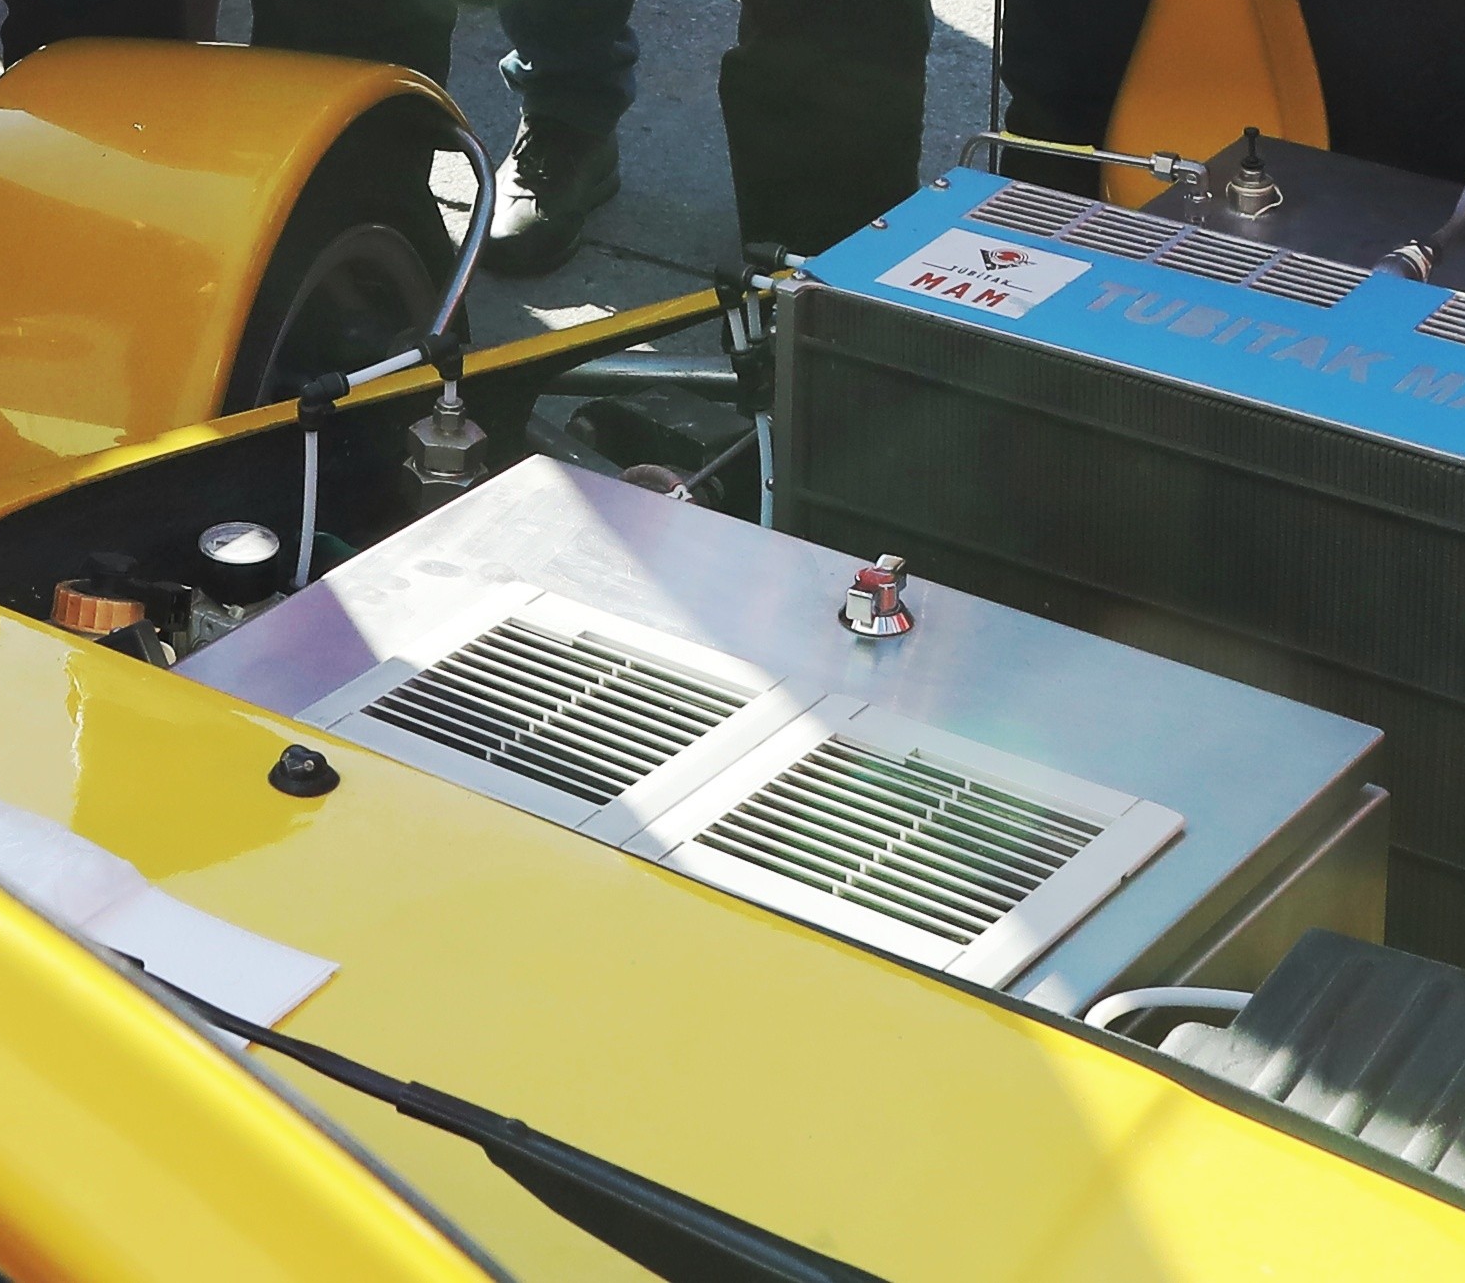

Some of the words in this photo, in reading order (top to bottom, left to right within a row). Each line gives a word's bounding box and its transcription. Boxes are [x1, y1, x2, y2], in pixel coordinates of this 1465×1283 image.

[909, 271, 1010, 308] MAM
[951, 264, 1010, 287] TÜBİTAK
[1085, 280, 1396, 385] TUBITAK
